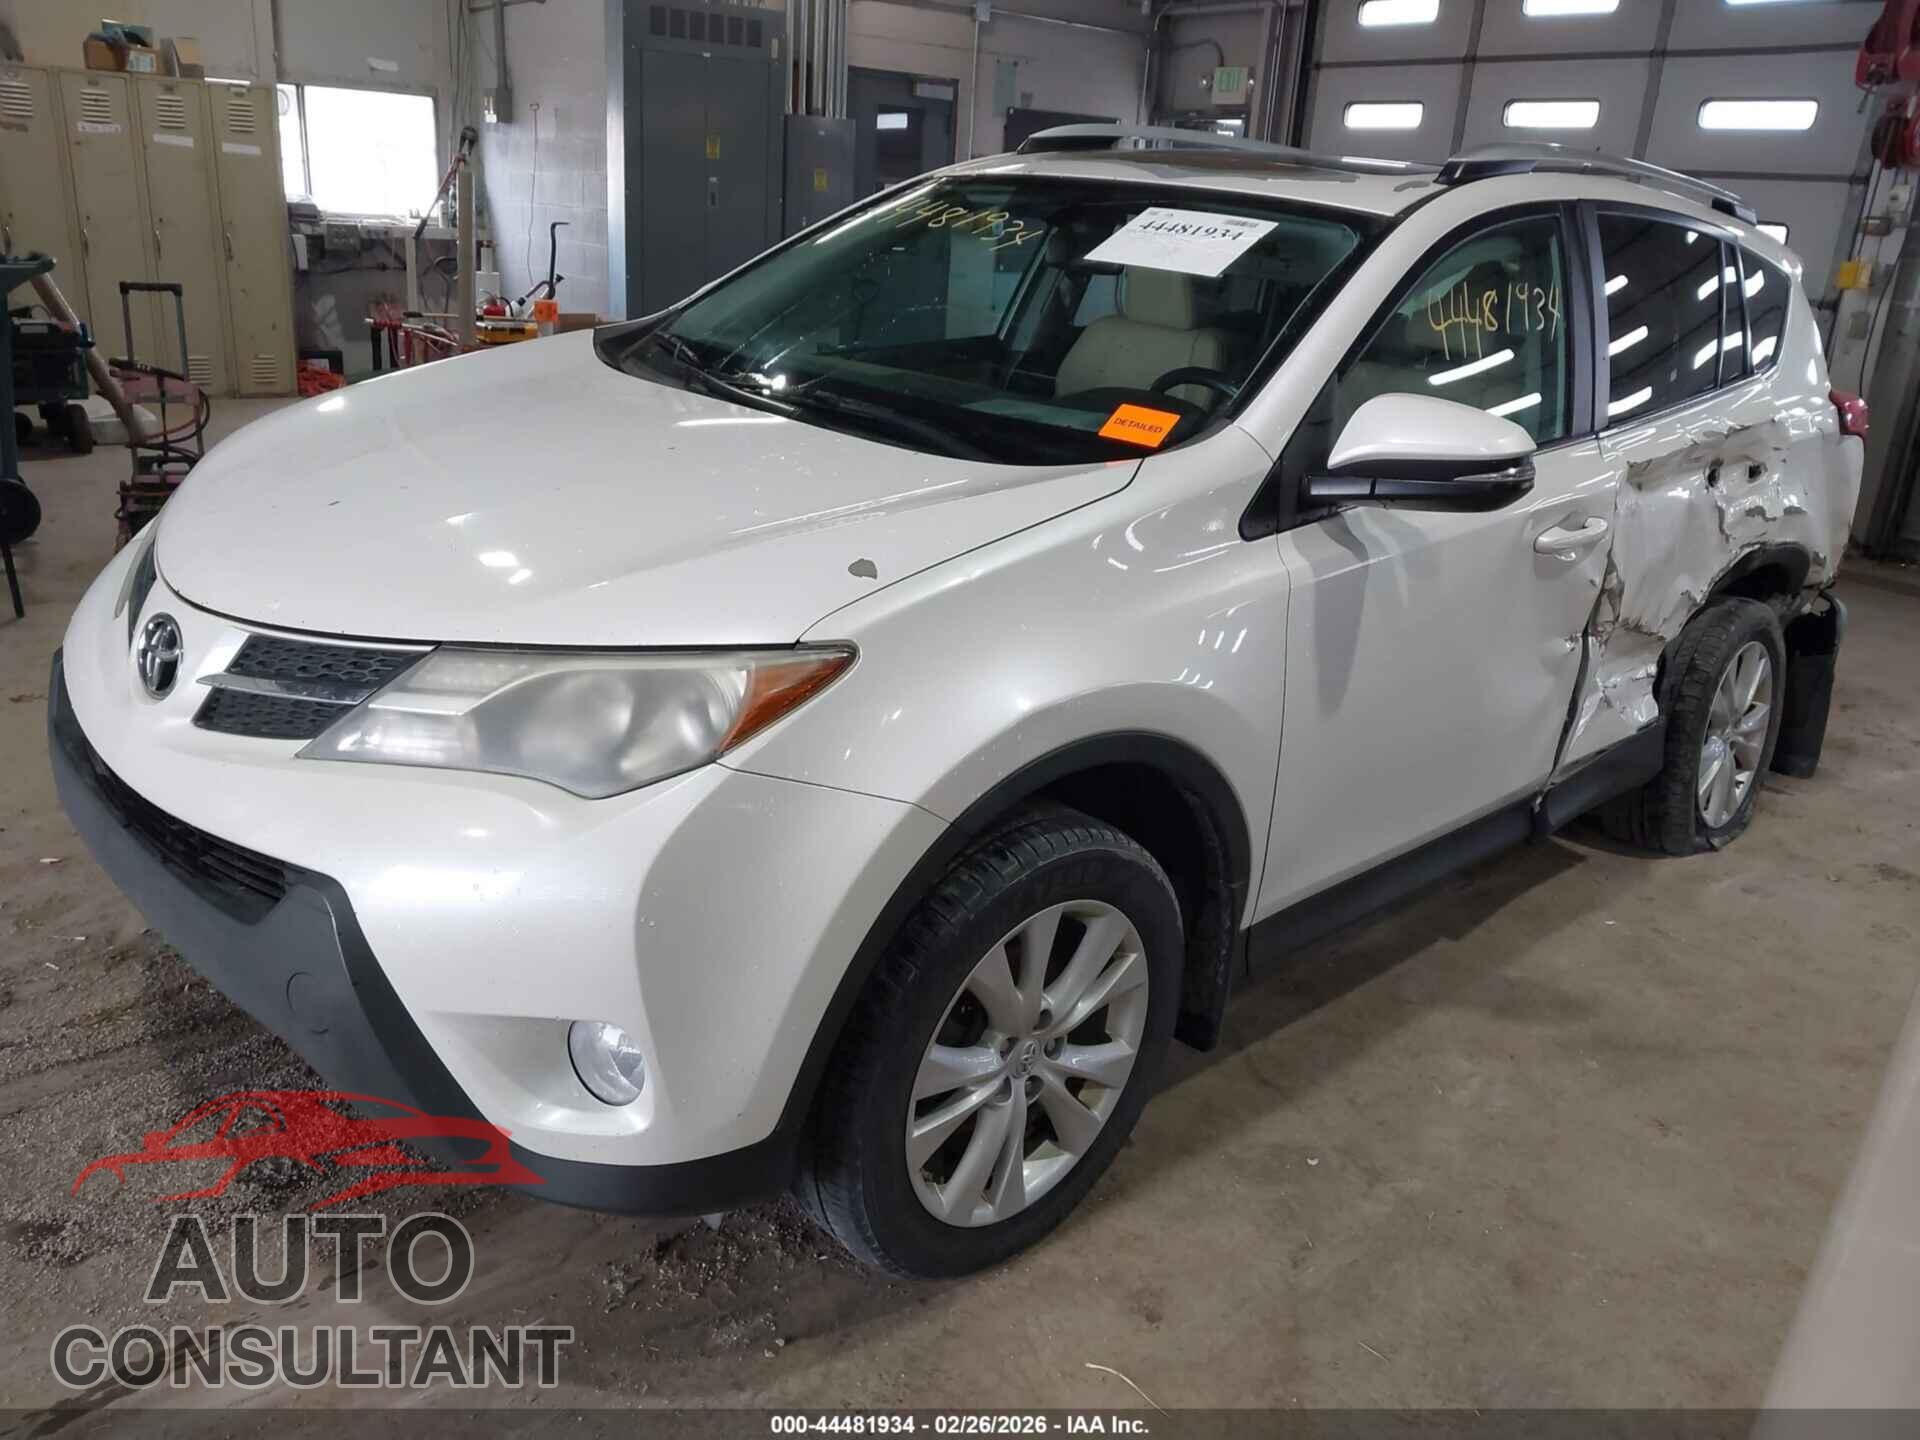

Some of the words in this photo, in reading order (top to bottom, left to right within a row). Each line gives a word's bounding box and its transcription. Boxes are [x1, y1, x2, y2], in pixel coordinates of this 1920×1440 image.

[1138, 219, 1244, 241] 44481934
[1427, 280, 1561, 360] 44481934
[1113, 417, 1163, 433] DETAILED
